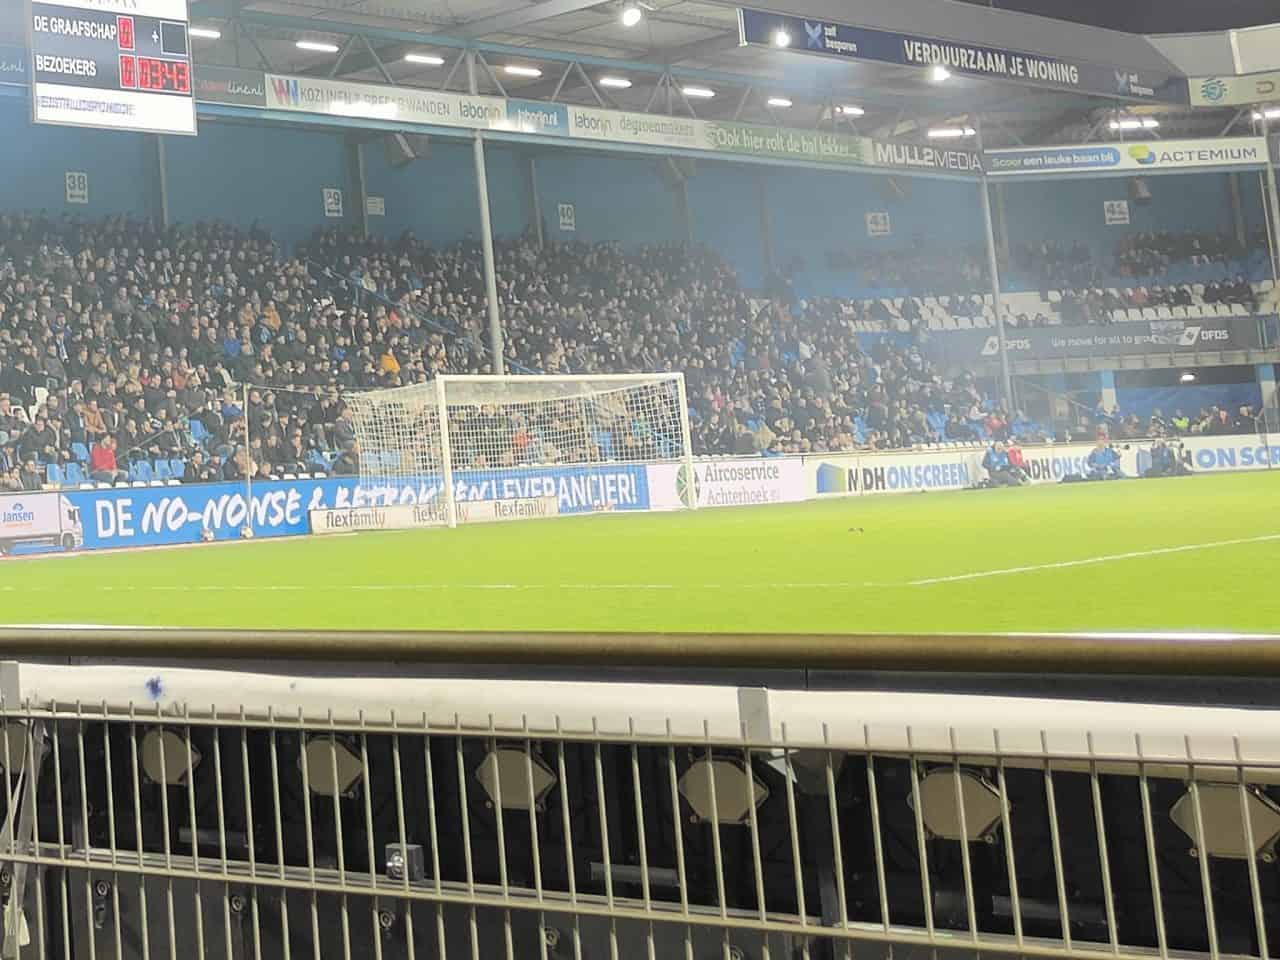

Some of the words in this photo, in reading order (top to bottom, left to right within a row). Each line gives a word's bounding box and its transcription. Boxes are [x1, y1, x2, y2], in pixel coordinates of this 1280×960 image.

[34, 16, 48, 32] DE
[50, 17, 117, 40] GRAAFSCHAP
[36, 54, 96, 77] BEZOEKERS
[904, 40, 1007, 73] VERDUURZAAM
[1010, 57, 1023, 76] JE
[1026, 59, 1079, 84] WONING
[459, 92, 501, 119] laborn
[717, 127, 739, 145] Ook
[877, 142, 982, 170] MULL2MEDIA
[1159, 147, 1257, 163] ACTEMIUM
[704, 463, 780, 482] Aircoservice
[707, 485, 769, 505] Achterhoek
[1, 511, 34, 523] Jansen
[95, 498, 134, 538] DE
[141, 487, 302, 534] NO-NONSE
[413, 503, 468, 522] flexfaily
[494, 498, 546, 517] flexfamily
[326, 509, 386, 528] flexfamily
